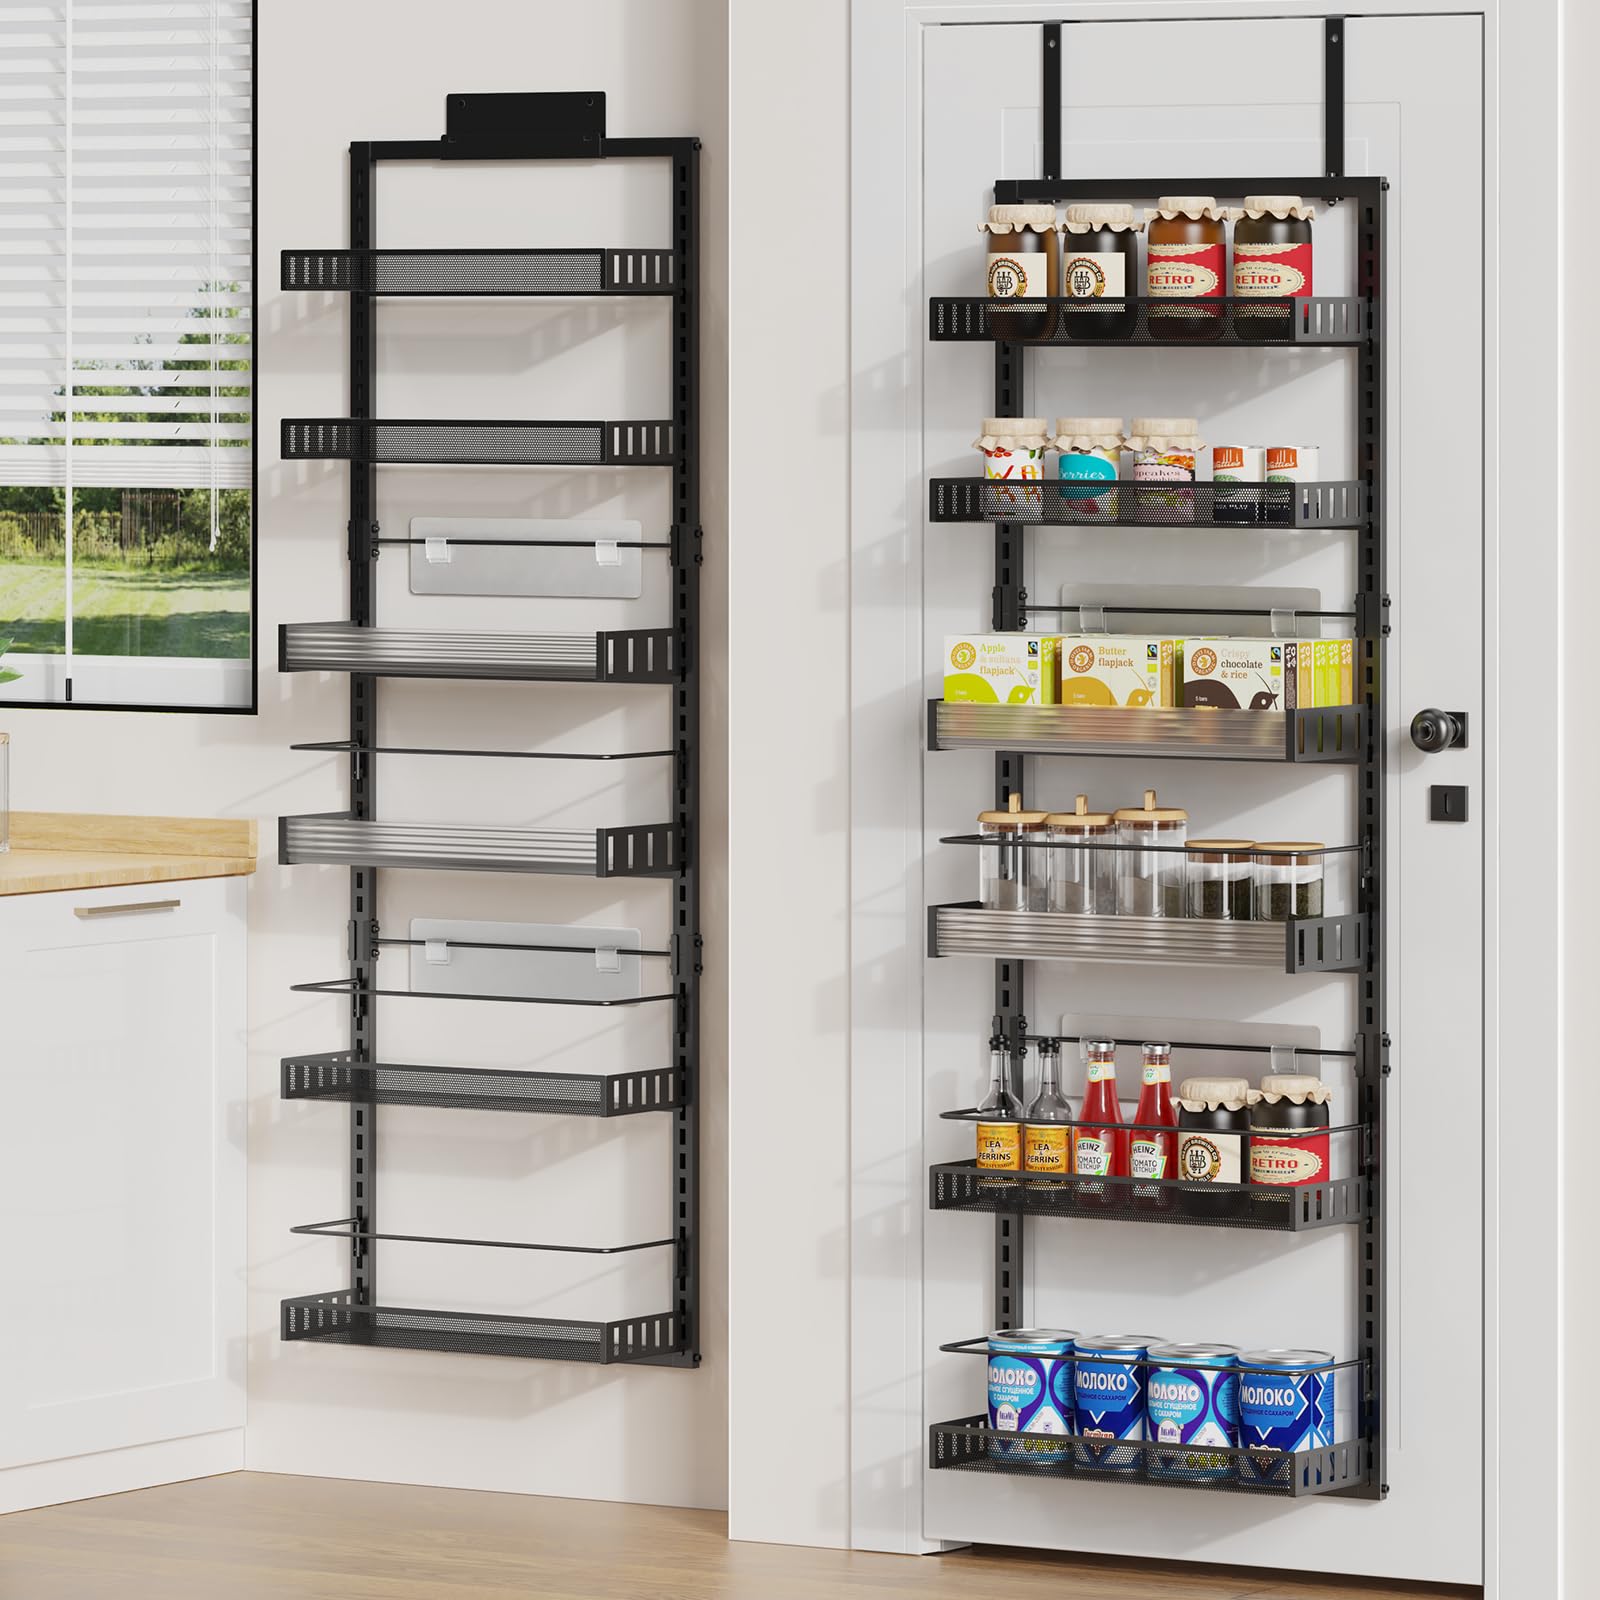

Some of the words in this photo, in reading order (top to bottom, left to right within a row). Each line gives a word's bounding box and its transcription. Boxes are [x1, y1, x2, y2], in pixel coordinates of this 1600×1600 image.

[1149, 275, 1195, 285] RETRO
[1235, 275, 1281, 285] RETRO
[980, 643, 1006, 655] Apple
[1098, 647, 1128, 656] Butter
[1220, 648, 1250, 659] Crispy
[1098, 658, 1134, 669] flapjack
[1221, 659, 1263, 669] chocolate
[979, 666, 1015, 677] flapjack
[1220, 671, 1228, 679] &
[1230, 670, 1248, 679] rice
[985, 1140, 1001, 1148] LEA
[1033, 1143, 1050, 1151] LEA
[1077, 1142, 1100, 1152] HEINZ
[1133, 1145, 1156, 1156] HEINZ
[979, 1152, 1011, 1161] PERRINS
[1027, 1154, 1060, 1164] PERRINS
[1252, 1157, 1298, 1169] RETRO
[1076, 1370, 1128, 1391] МОЛОКО
[1241, 1385, 1295, 1406] МОЛОКО
